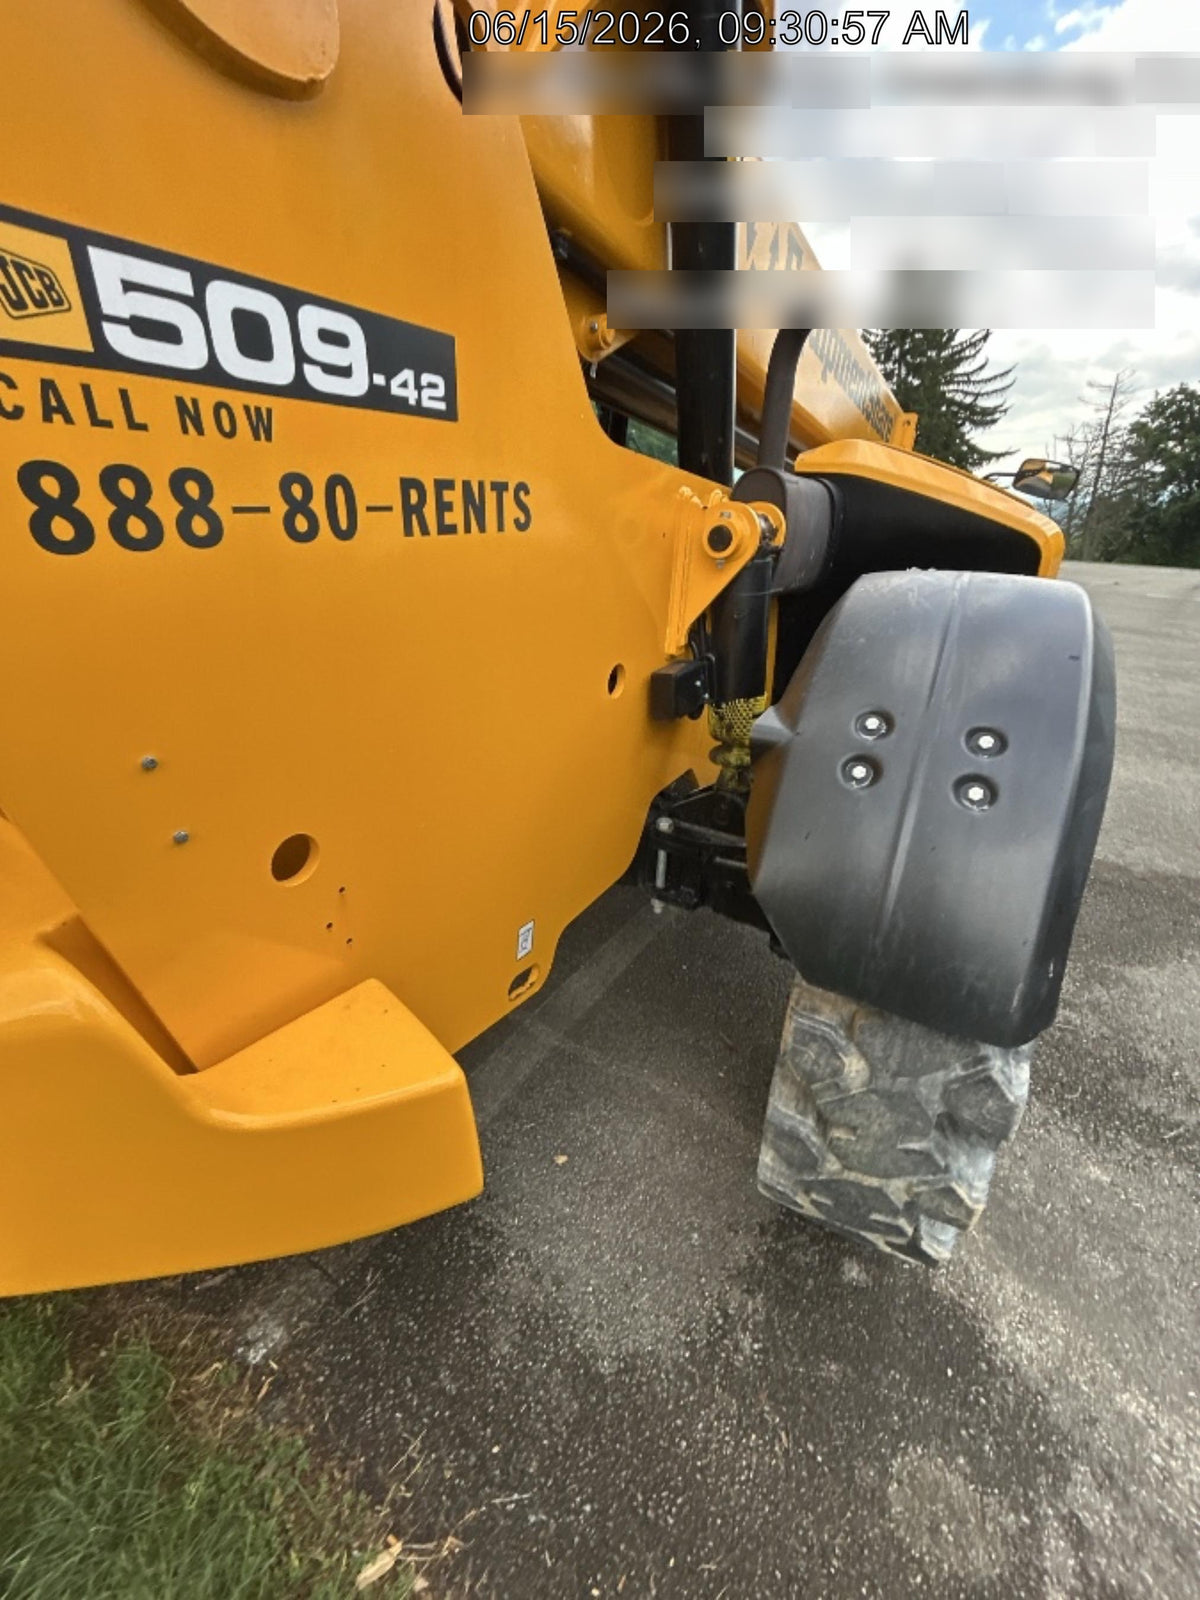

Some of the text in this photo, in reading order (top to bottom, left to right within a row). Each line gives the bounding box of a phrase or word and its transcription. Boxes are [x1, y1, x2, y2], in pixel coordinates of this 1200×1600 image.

[0, 254, 65, 311] JCB
[87, 245, 447, 411] 509-42
[0, 372, 273, 443] CALL NOW
[16, 459, 532, 556] 888-80-RENTS
